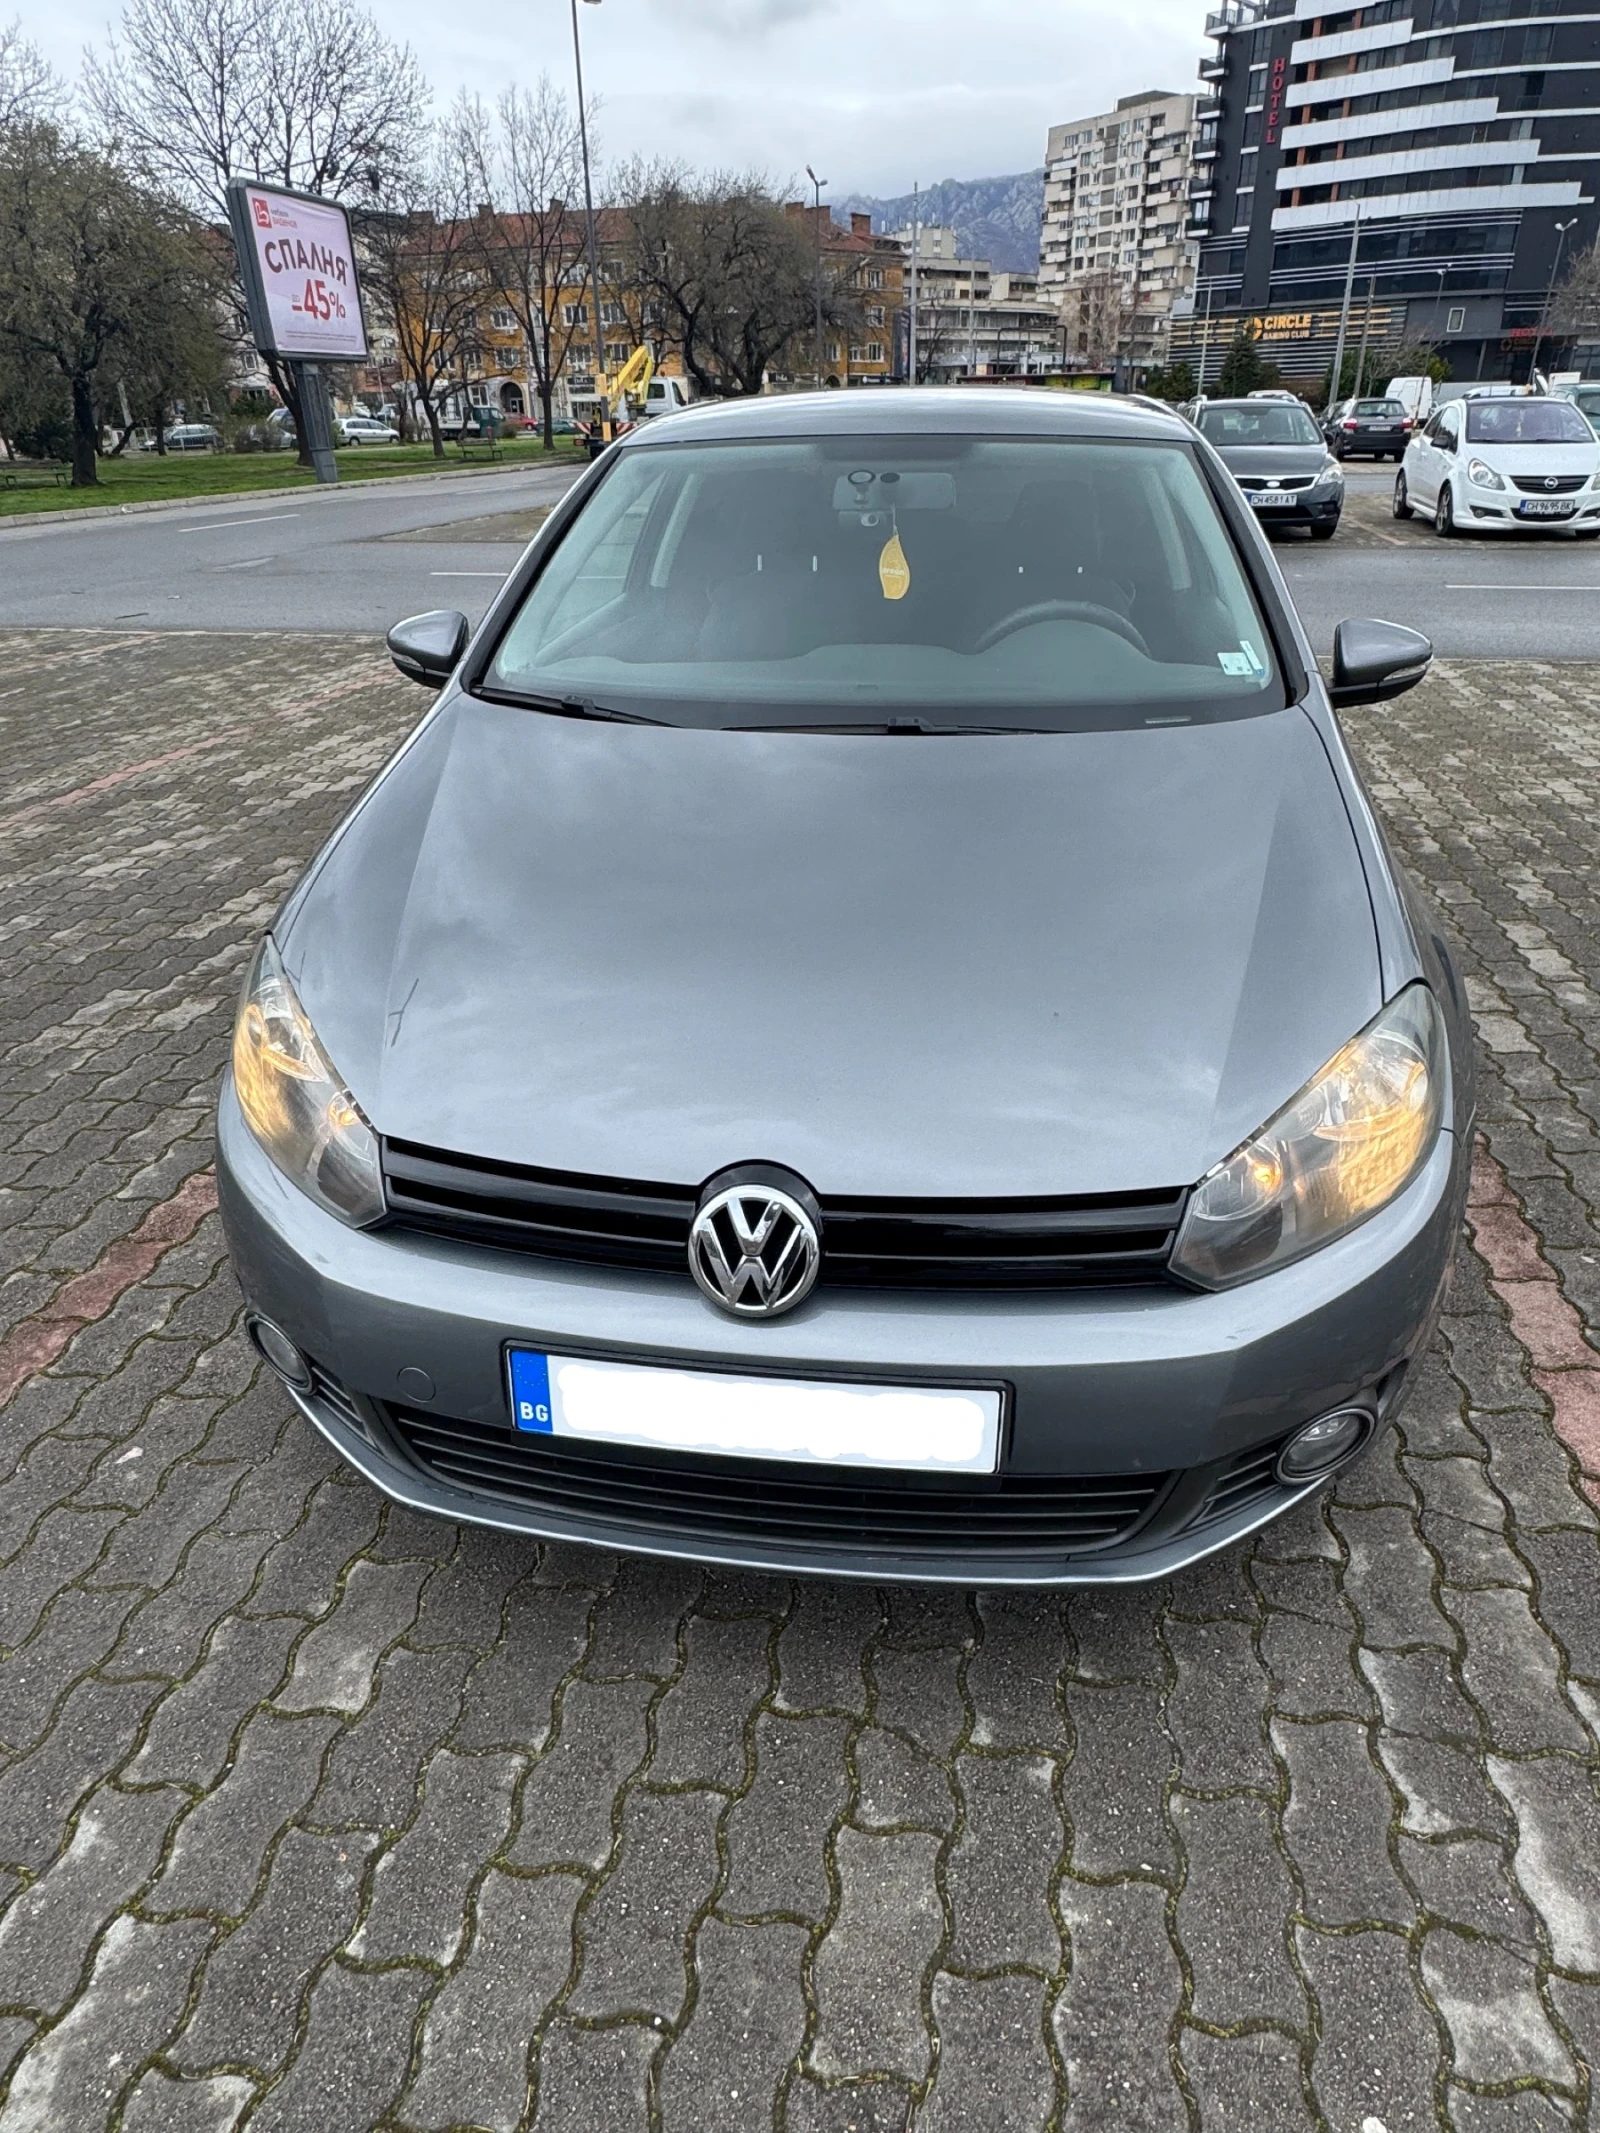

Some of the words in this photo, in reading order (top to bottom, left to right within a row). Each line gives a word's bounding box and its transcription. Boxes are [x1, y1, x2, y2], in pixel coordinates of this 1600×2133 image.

[1266, 58, 1286, 143] HOTEL
[1264, 314, 1312, 329] CIRCLE
[520, 1401, 549, 1423] BG
